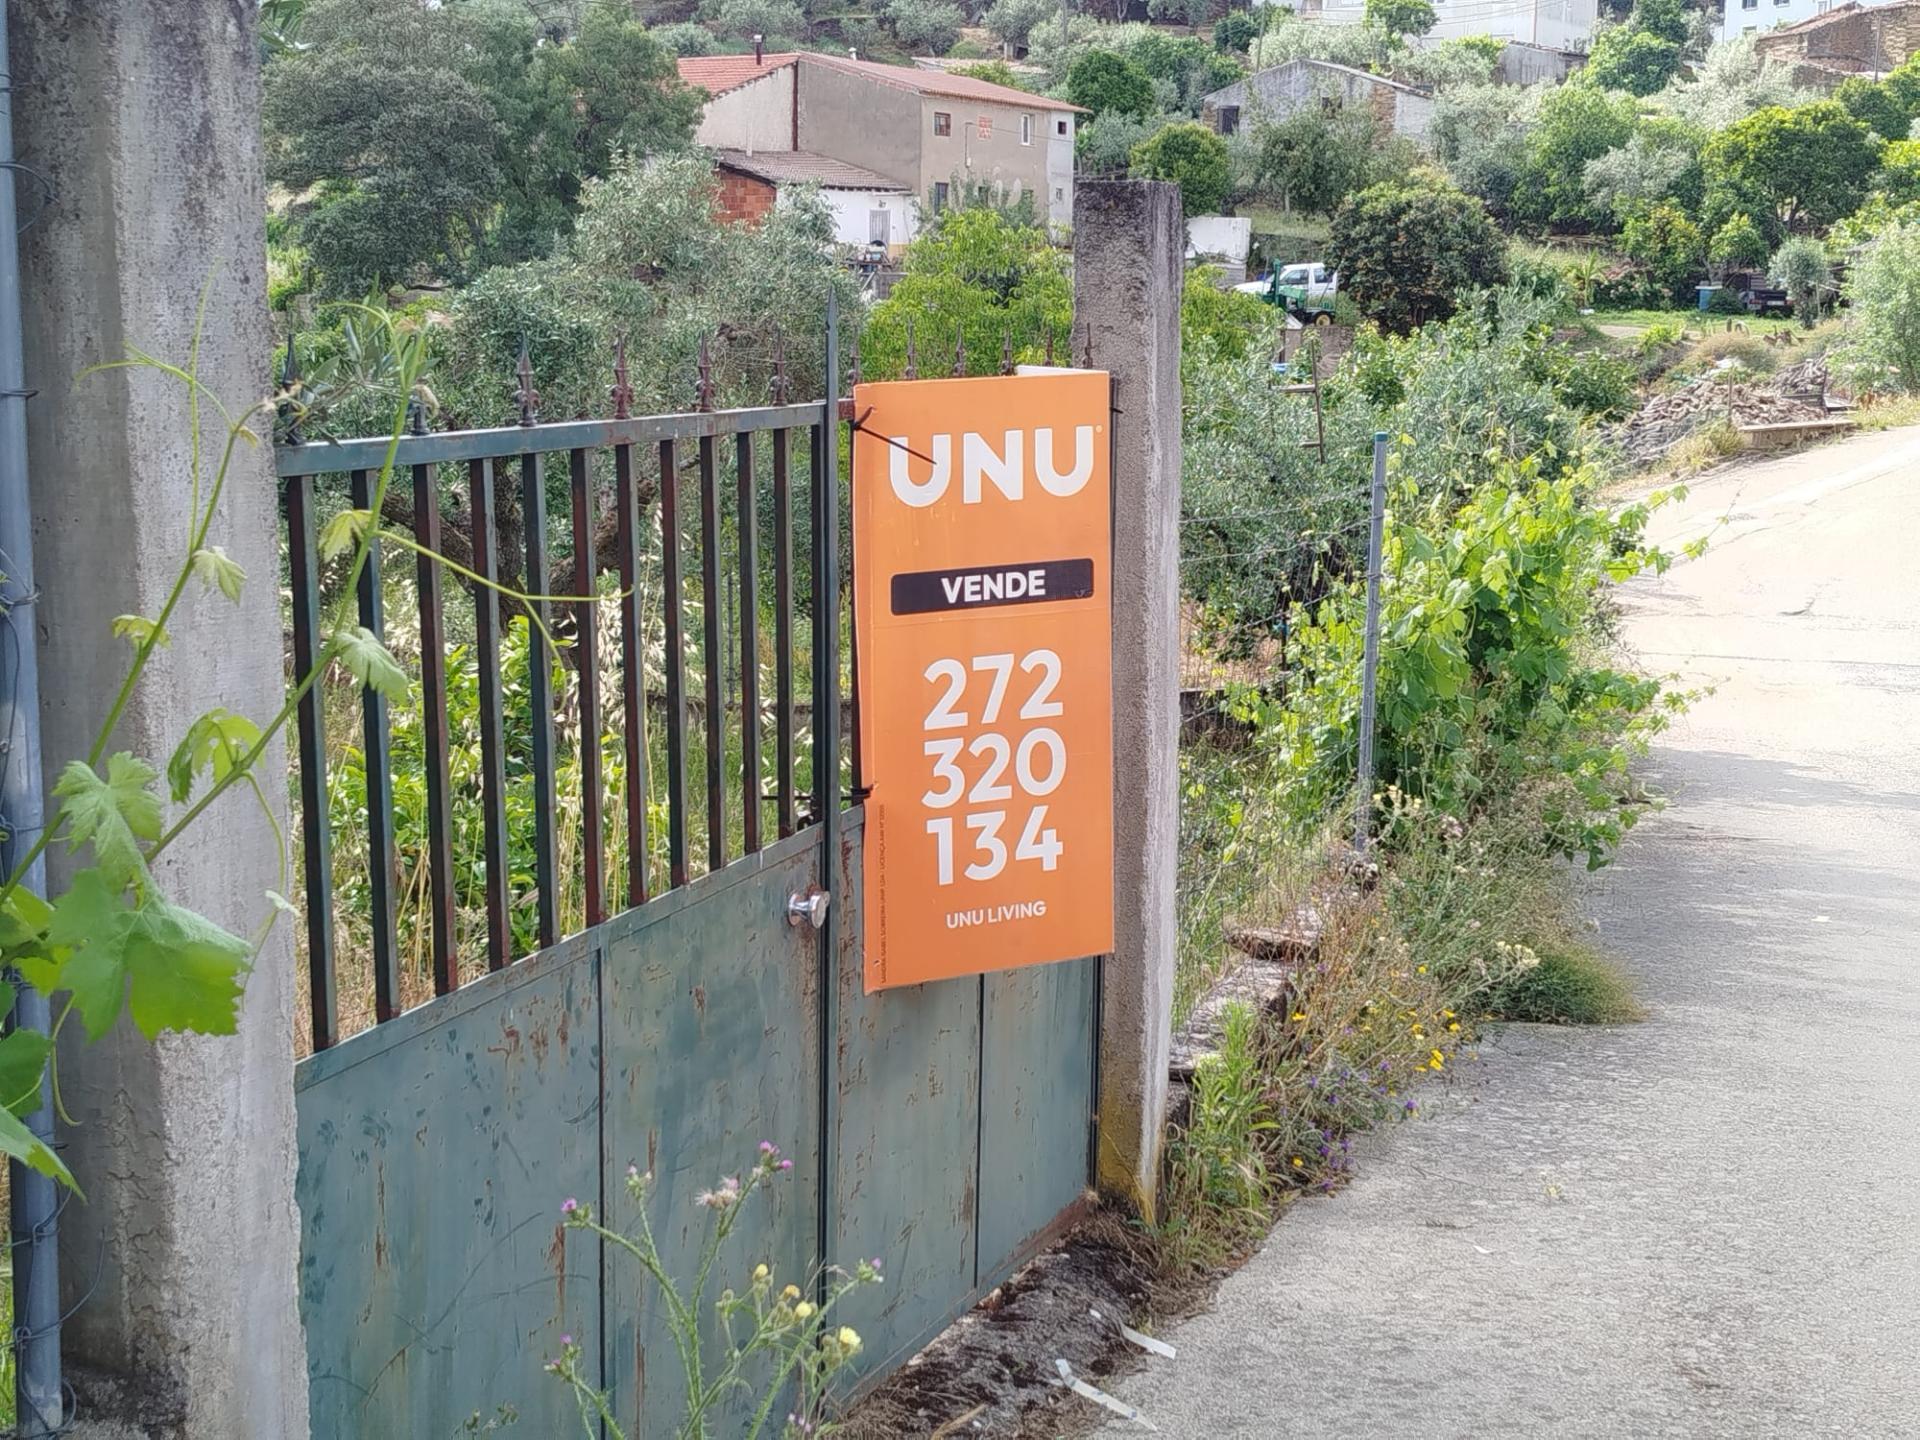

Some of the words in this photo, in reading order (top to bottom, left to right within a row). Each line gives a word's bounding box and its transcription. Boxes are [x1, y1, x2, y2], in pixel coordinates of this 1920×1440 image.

[941, 569, 1046, 604] VENDE
[924, 649, 1063, 730] 272
[921, 727, 1067, 809] 320
[926, 805, 1063, 886] 134
[946, 909, 984, 928] UNU
[987, 900, 1047, 924] LIVING
